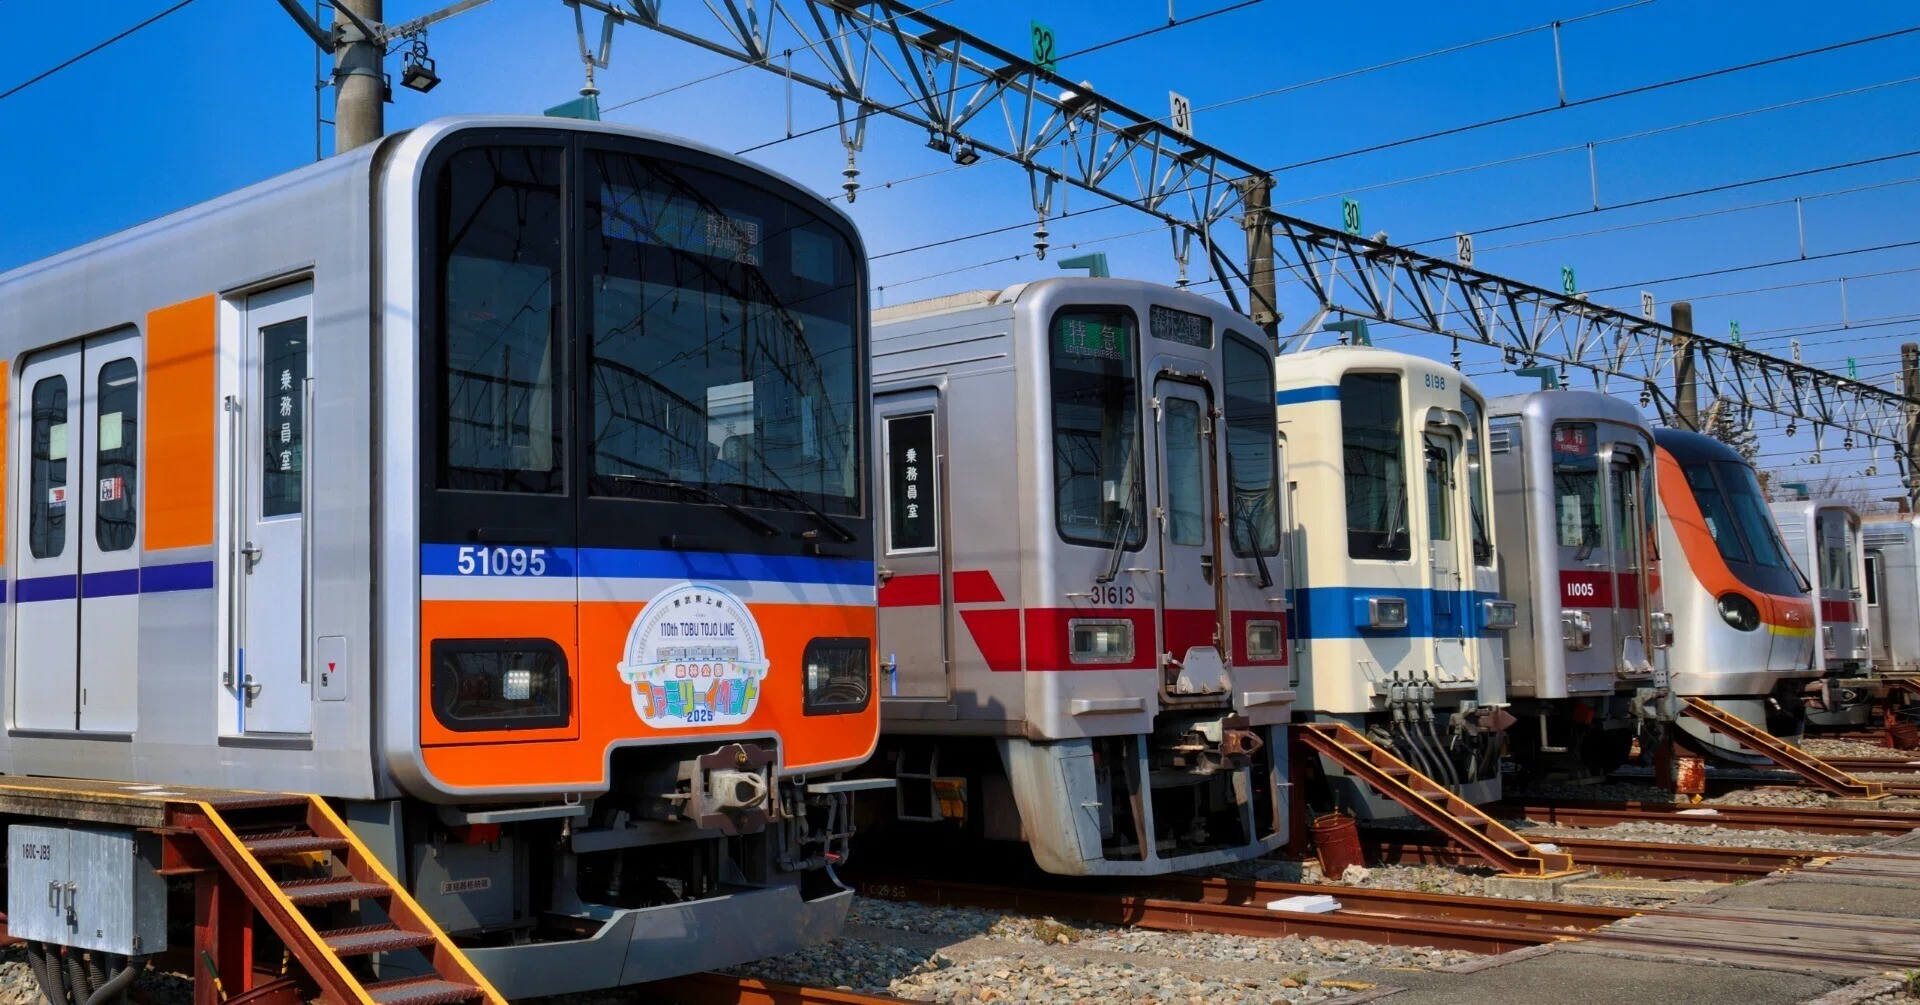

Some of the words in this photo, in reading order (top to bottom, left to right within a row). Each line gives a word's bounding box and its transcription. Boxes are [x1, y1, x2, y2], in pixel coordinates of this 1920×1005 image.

[1034, 26, 1054, 66] 32
[1174, 97, 1189, 131] 31
[1344, 201, 1359, 231] 30
[1458, 235, 1471, 263] 29
[1643, 294, 1653, 316] 27
[1068, 319, 1117, 351] 特急
[1152, 308, 1201, 342] 森林公園
[1093, 348, 1123, 361] EXPRESS
[1424, 373, 1446, 391] 8198
[279, 368, 293, 472] 乗務員室
[905, 447, 919, 519] 乗務員室
[457, 546, 546, 576] 51095
[673, 594, 724, 609] 東武東上線
[1090, 585, 1135, 605] 31613
[1567, 582, 1594, 597] 11005
[660, 622, 679, 638] 110th
[680, 622, 699, 637] TOBU
[700, 622, 718, 637] TOJO
[719, 622, 735, 637] LINE
[675, 663, 724, 679] 森林公園
[634, 677, 758, 719] ファミリーイベント
[687, 709, 714, 723] 2025
[22, 843, 51, 861] 160C-JB3
